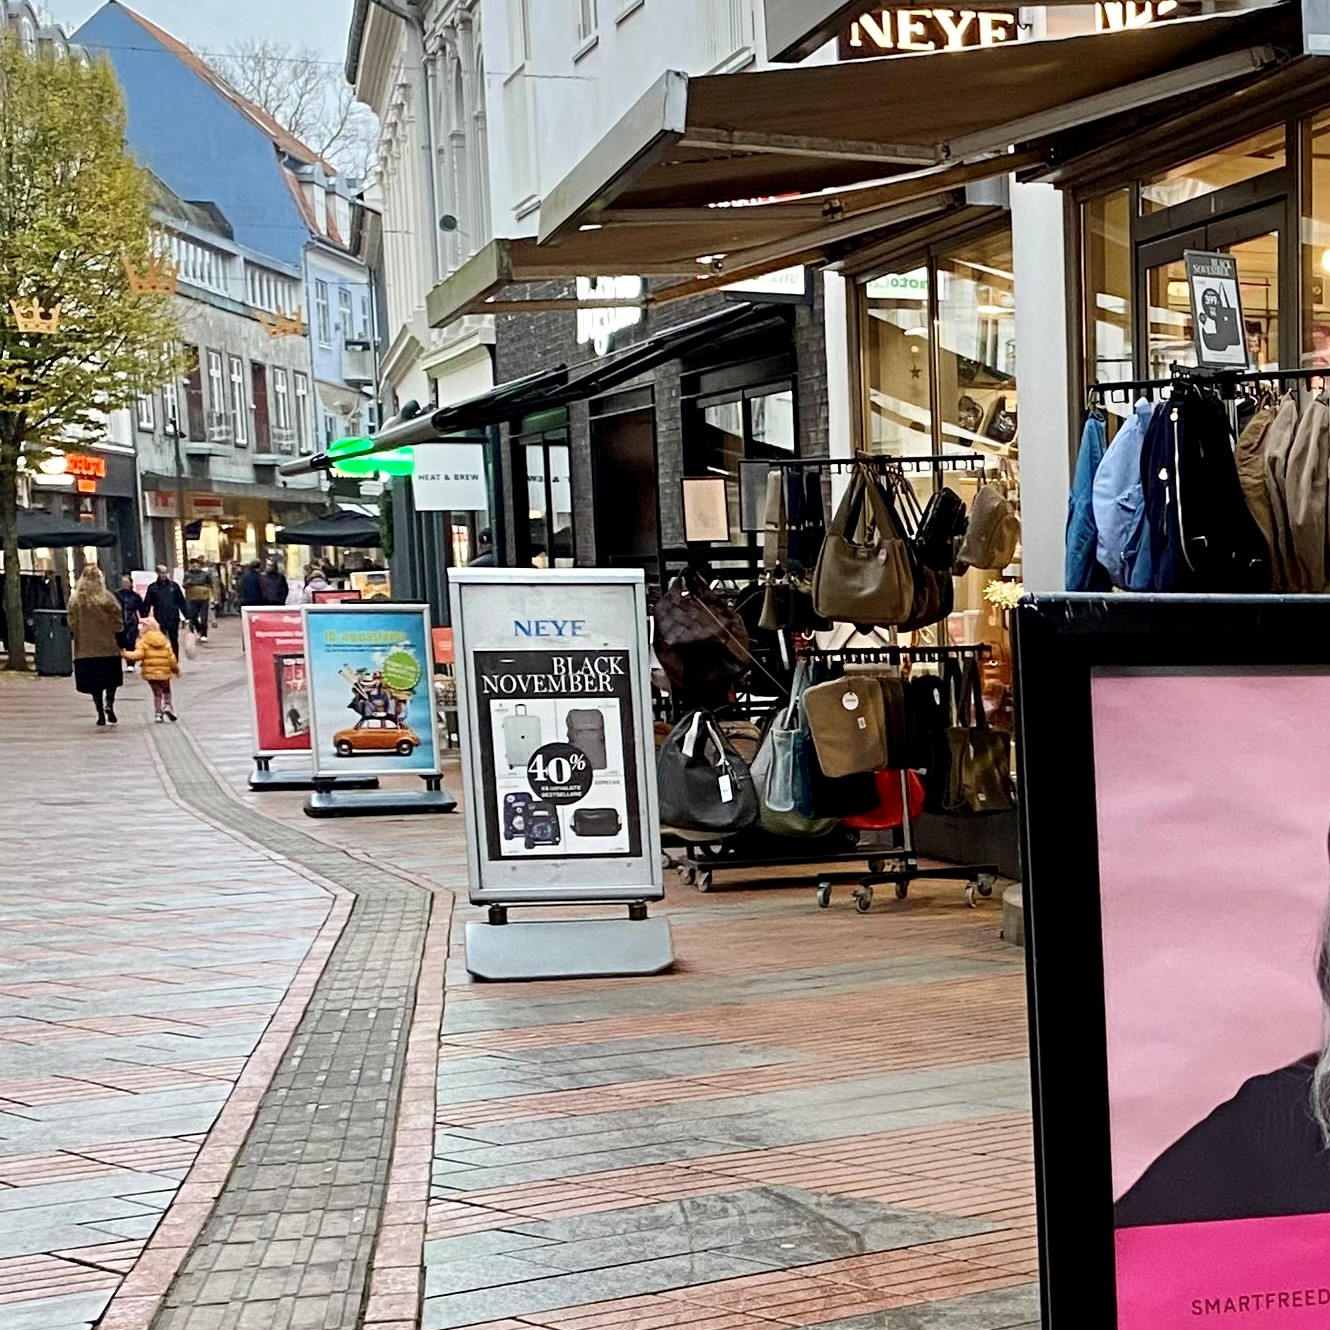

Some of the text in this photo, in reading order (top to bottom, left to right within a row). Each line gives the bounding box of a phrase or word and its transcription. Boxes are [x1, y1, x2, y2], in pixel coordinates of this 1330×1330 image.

[454, 473, 479, 481] BREW
[514, 620, 586, 637] NEYE
[553, 657, 625, 676] BLACK
[482, 675, 614, 694] NOVEMBER
[528, 753, 586, 784] 40%
